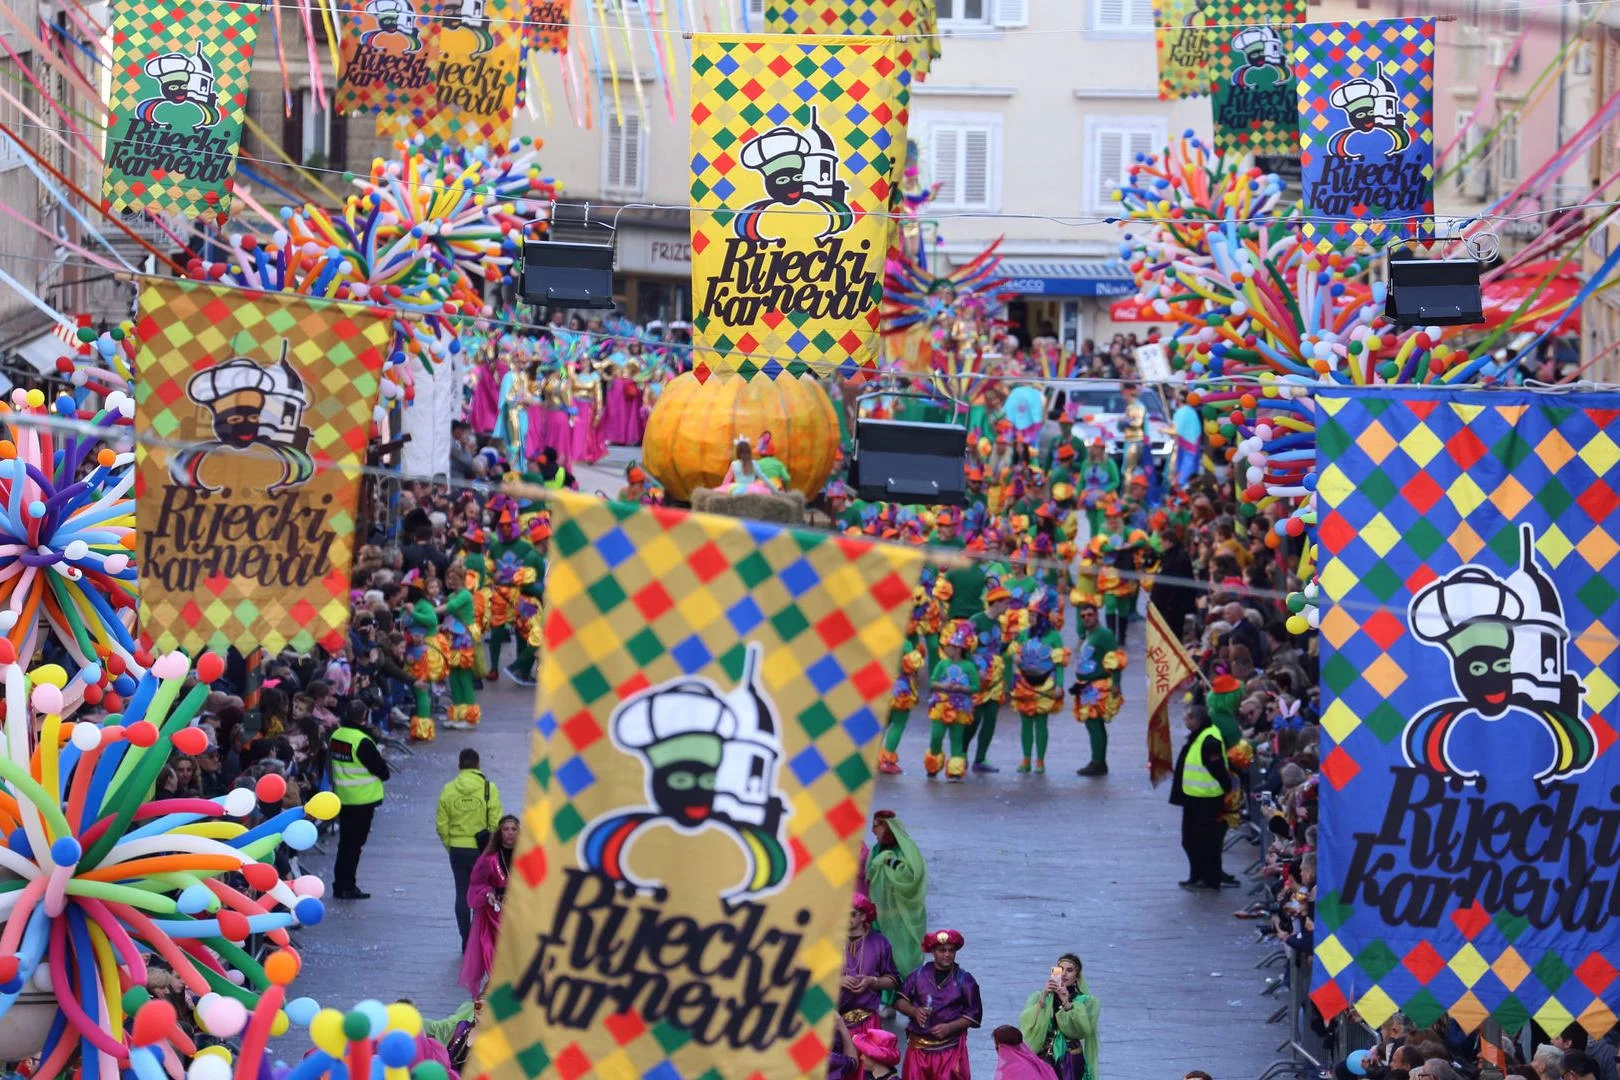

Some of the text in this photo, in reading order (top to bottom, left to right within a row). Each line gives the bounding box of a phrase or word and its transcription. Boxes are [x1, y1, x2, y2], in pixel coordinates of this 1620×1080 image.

[342, 62, 432, 89] karneval
[352, 44, 429, 76] Riječki
[436, 52, 504, 94] ječki
[436, 83, 505, 116] neval
[1218, 104, 1299, 129] karneva
[121, 118, 231, 162] Riječki
[109, 141, 234, 183] karneval
[1321, 154, 1424, 192] Riječki
[1310, 176, 1427, 215] karneval
[720, 237, 871, 294] Riječki
[703, 272, 877, 327] karneval
[155, 485, 333, 554] Riječki
[141, 531, 336, 592] karneval
[1376, 766, 1620, 884] Riječki
[551, 867, 811, 1000] Riječki
[515, 933, 811, 1052] karneval
